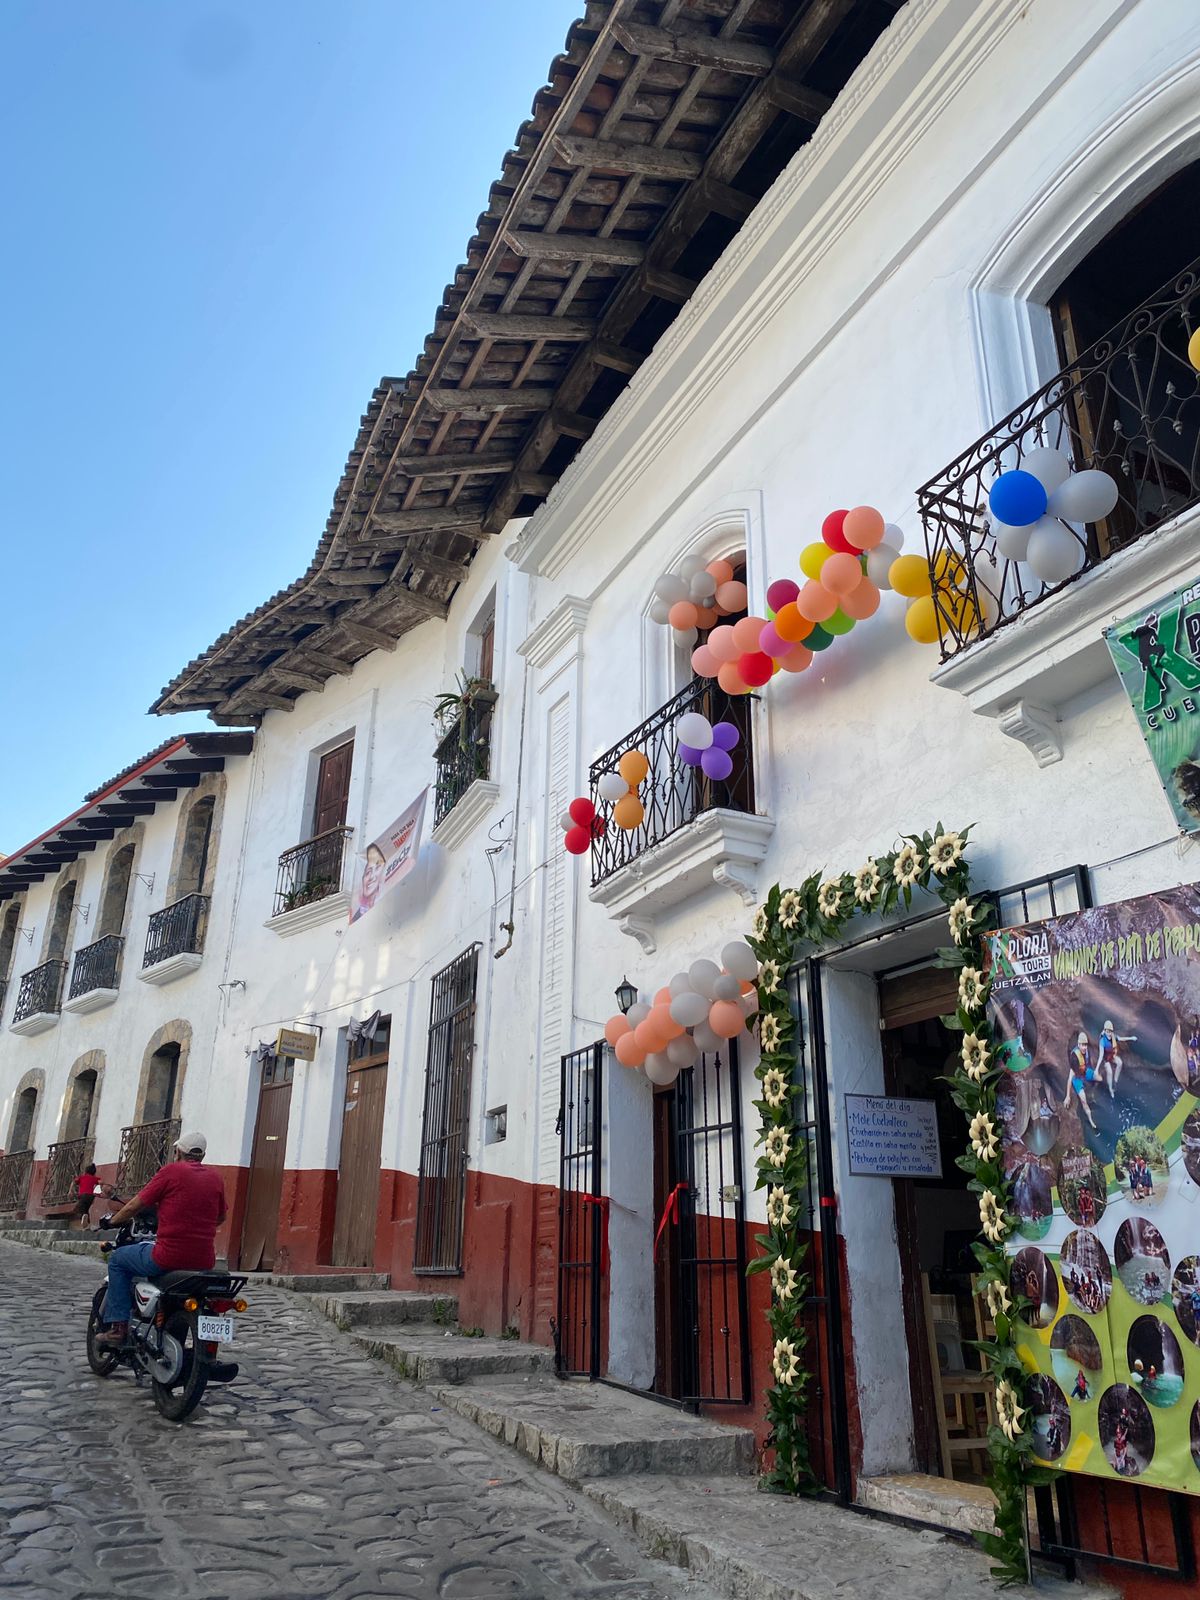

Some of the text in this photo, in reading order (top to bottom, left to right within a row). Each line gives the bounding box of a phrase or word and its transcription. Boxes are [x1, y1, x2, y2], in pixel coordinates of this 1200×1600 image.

[1101, 941, 1115, 970] DE
[1118, 932, 1143, 968] PATA
[1145, 931, 1161, 961] DE
[1022, 959, 1051, 972] TOURS
[885, 1099, 897, 1110] del
[852, 1112, 870, 1124] Mole
[878, 1153, 886, 1163] de
[201, 1322, 230, 1335] 8082F8
